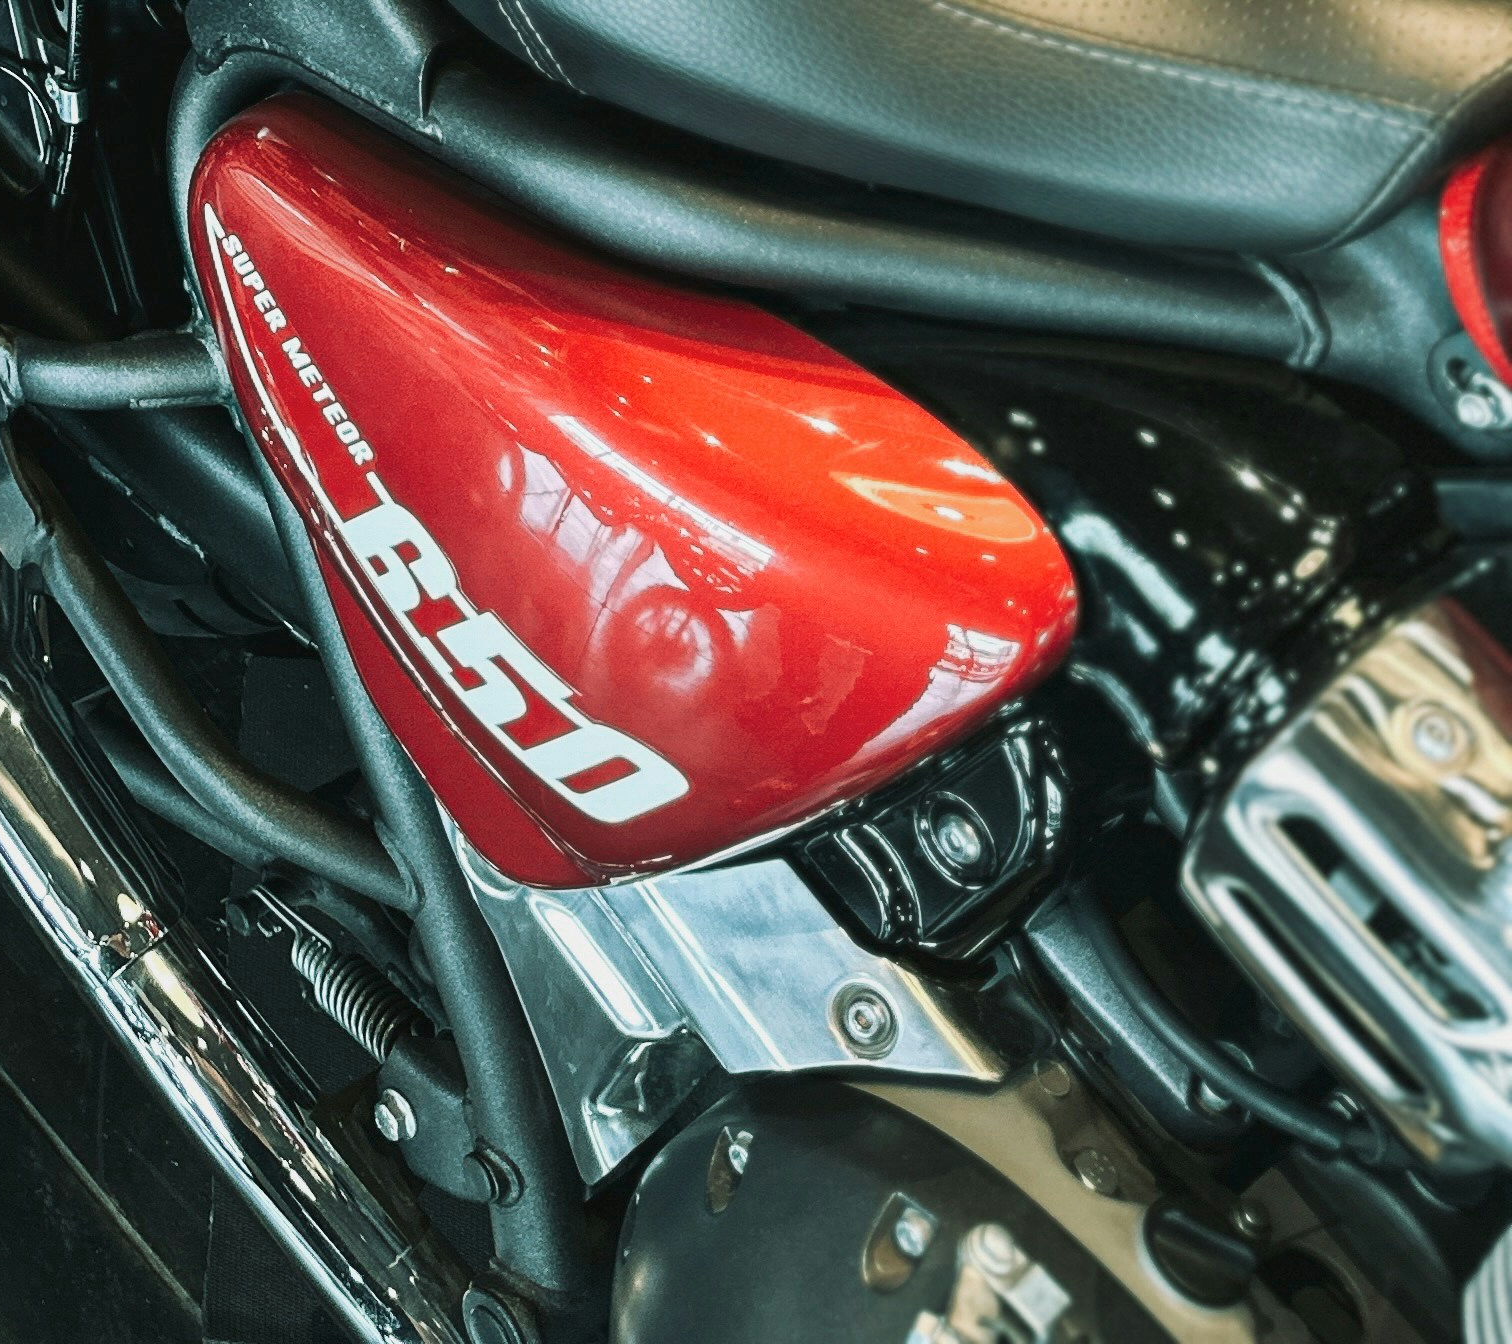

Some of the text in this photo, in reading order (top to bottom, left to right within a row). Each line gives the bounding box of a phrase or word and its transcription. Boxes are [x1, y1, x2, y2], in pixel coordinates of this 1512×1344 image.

[219, 232, 376, 467] SUPER METEOR
[341, 471, 690, 824] 650
